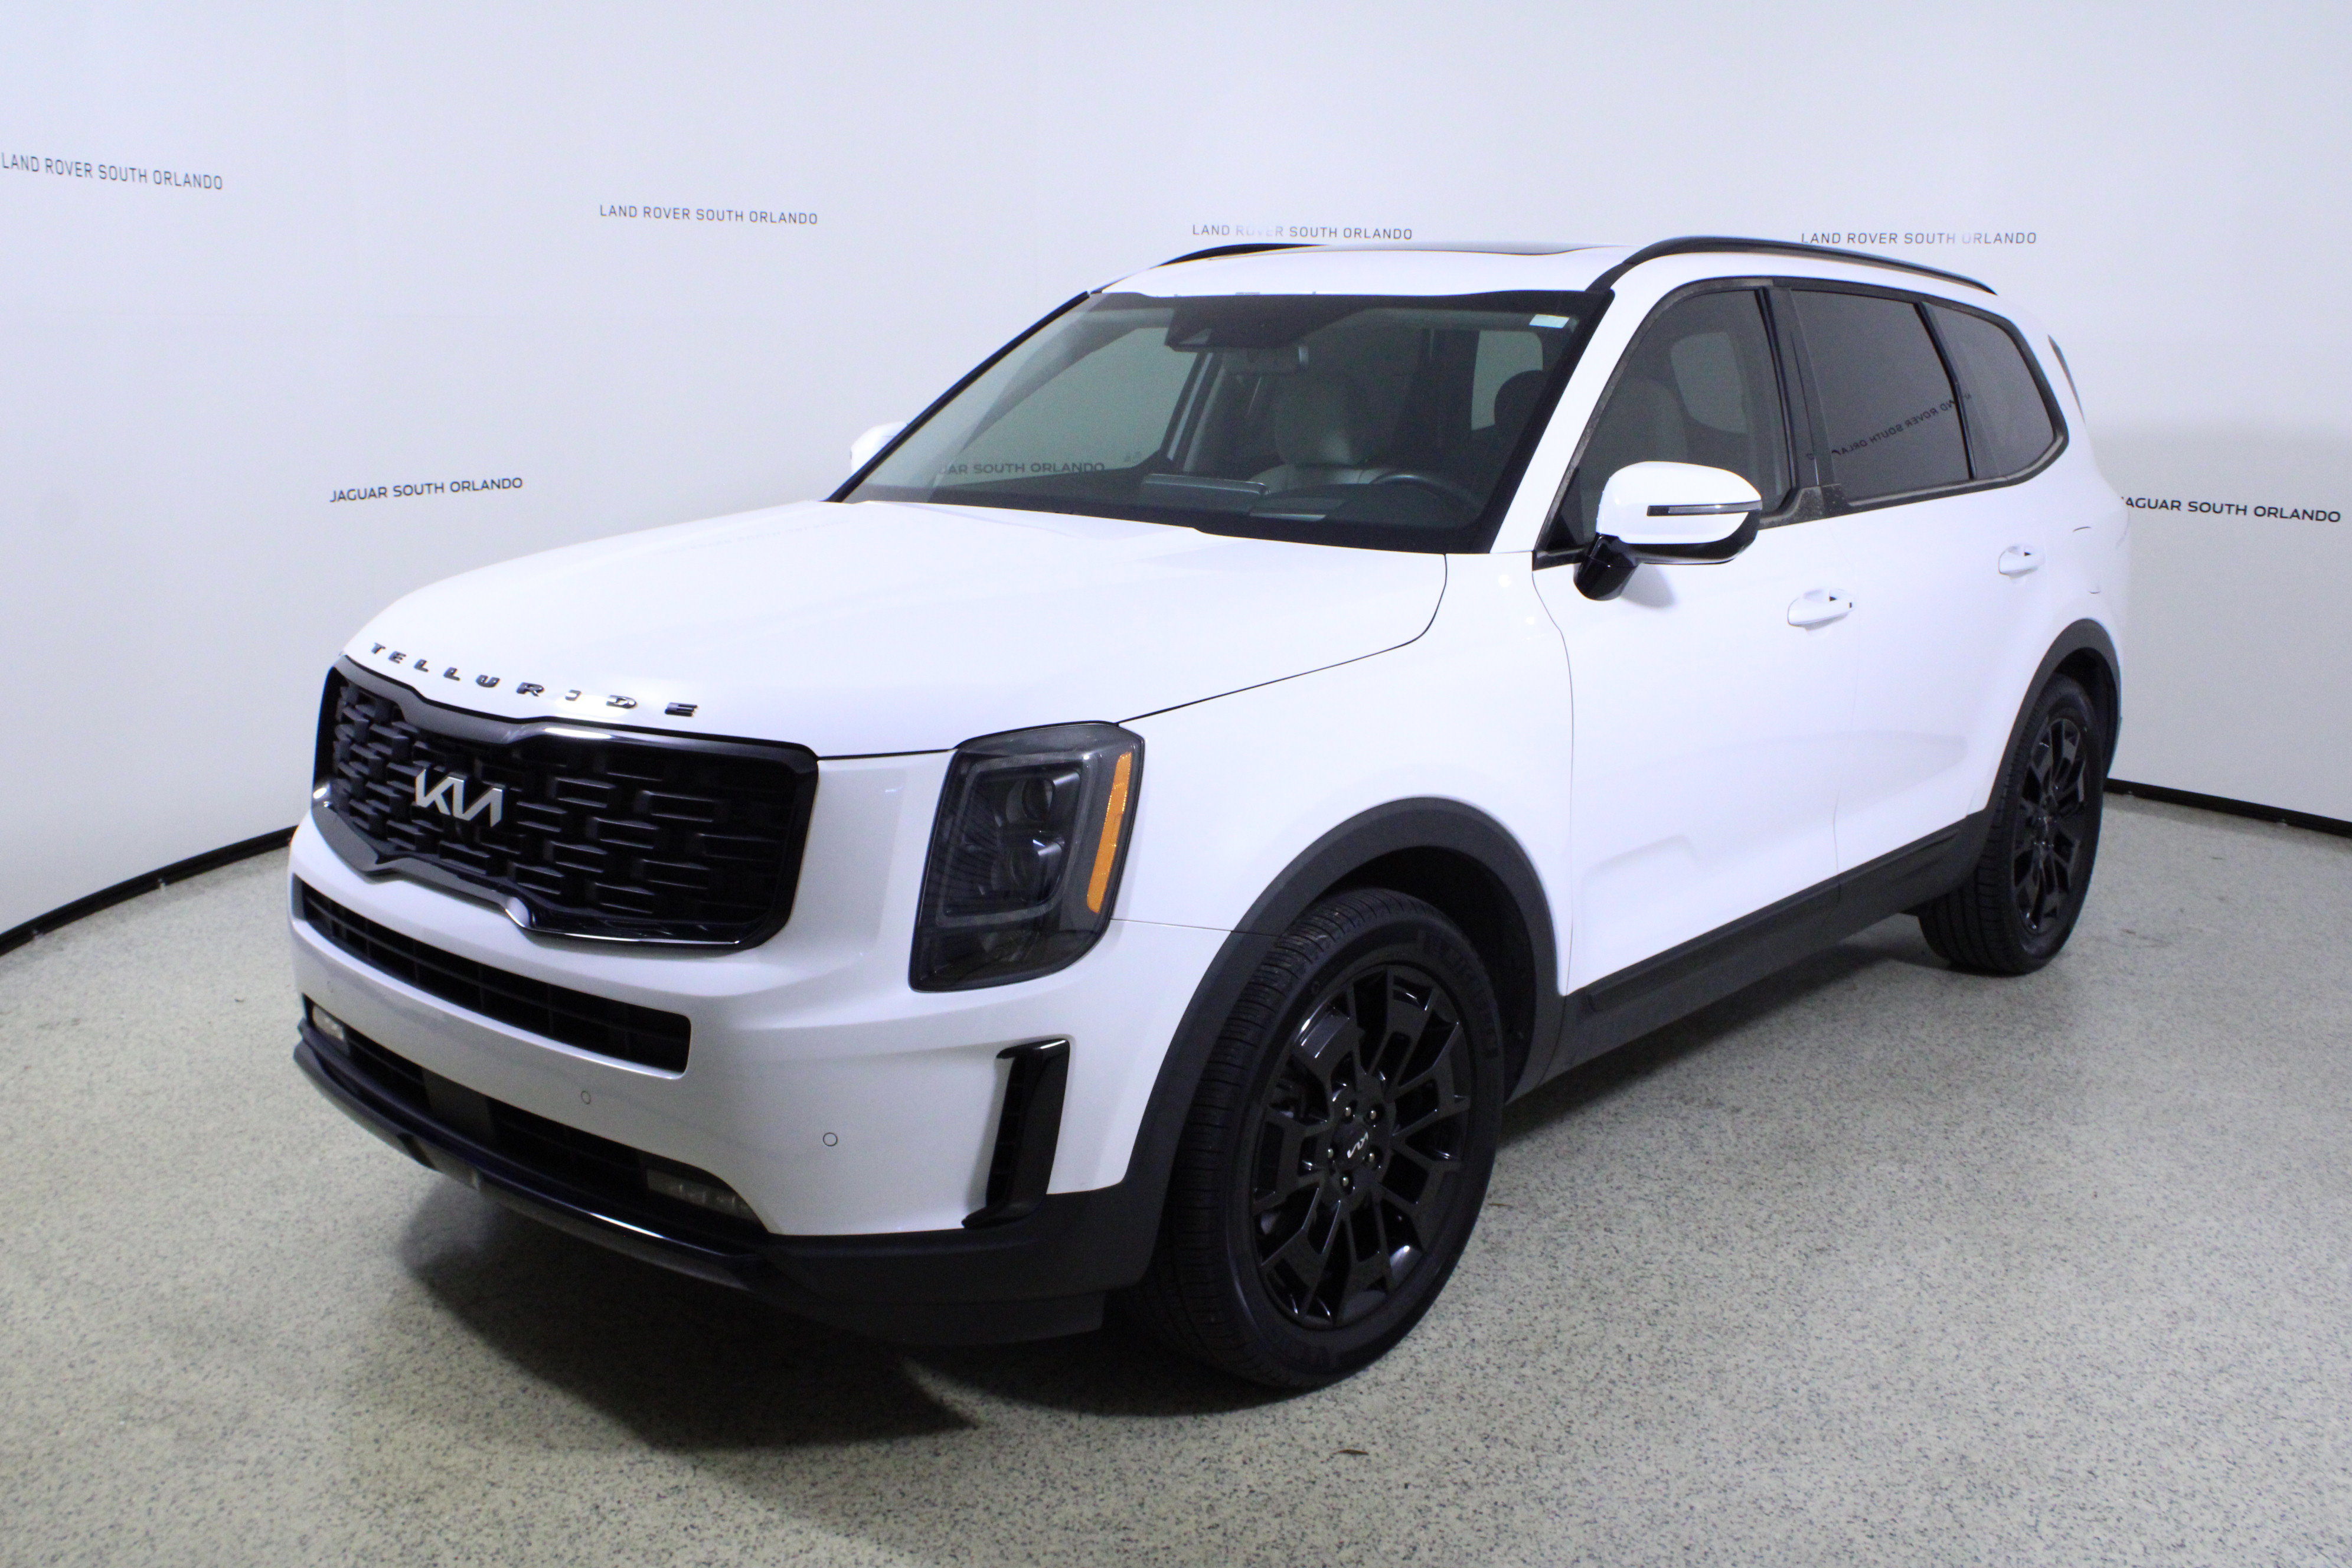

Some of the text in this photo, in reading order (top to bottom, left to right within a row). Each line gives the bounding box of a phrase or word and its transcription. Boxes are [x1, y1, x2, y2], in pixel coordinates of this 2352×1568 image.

[2, 152, 223, 190] LAND ROVER SOUTH ORLANDO
[599, 204, 818, 225] LAND ROVER SOUTH ORLANDO
[1192, 224, 1230, 236] LAND
[1289, 226, 1338, 238] SOUTH
[1343, 227, 1413, 240] ORLANDO
[1801, 233, 1841, 244] LAND
[1847, 232, 1898, 244] ROVER
[1904, 232, 1956, 244] SOUTH
[973, 462, 1025, 473] SOUTH
[1030, 462, 1105, 473] ORLANDO
[329, 477, 524, 502] JAGUAR SOUTH ORLANDO
[2121, 496, 2342, 522] AGUAR SOUTH ORLANDO
[371, 642, 698, 716] TELLURIDE
[414, 768, 503, 827] KIA
